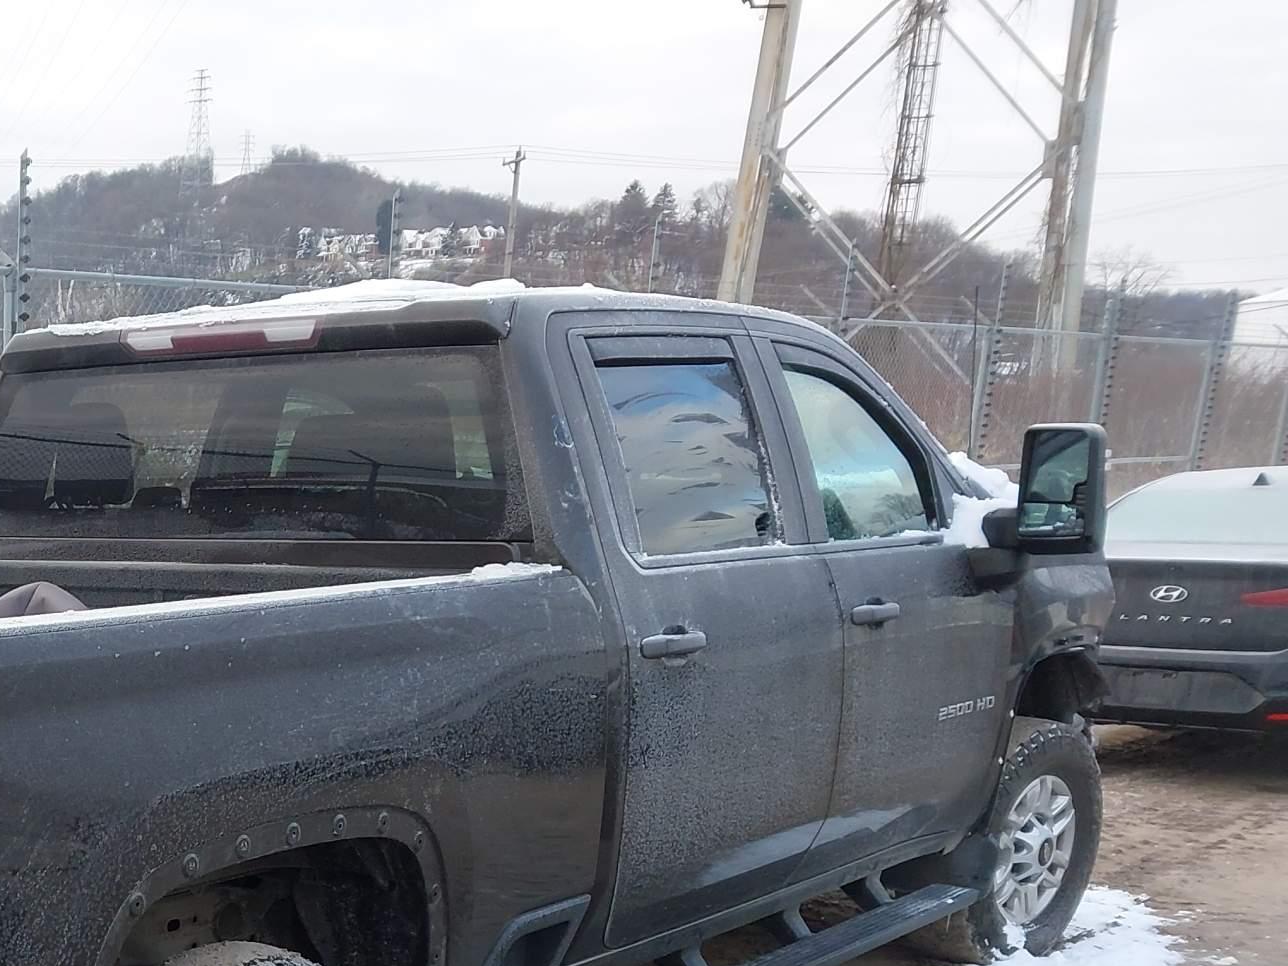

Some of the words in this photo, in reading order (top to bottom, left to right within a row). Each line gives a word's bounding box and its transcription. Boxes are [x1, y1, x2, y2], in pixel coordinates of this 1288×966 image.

[1119, 614, 1233, 624] LANTRA
[938, 700, 974, 721] 2500
[976, 695, 995, 711] HD
